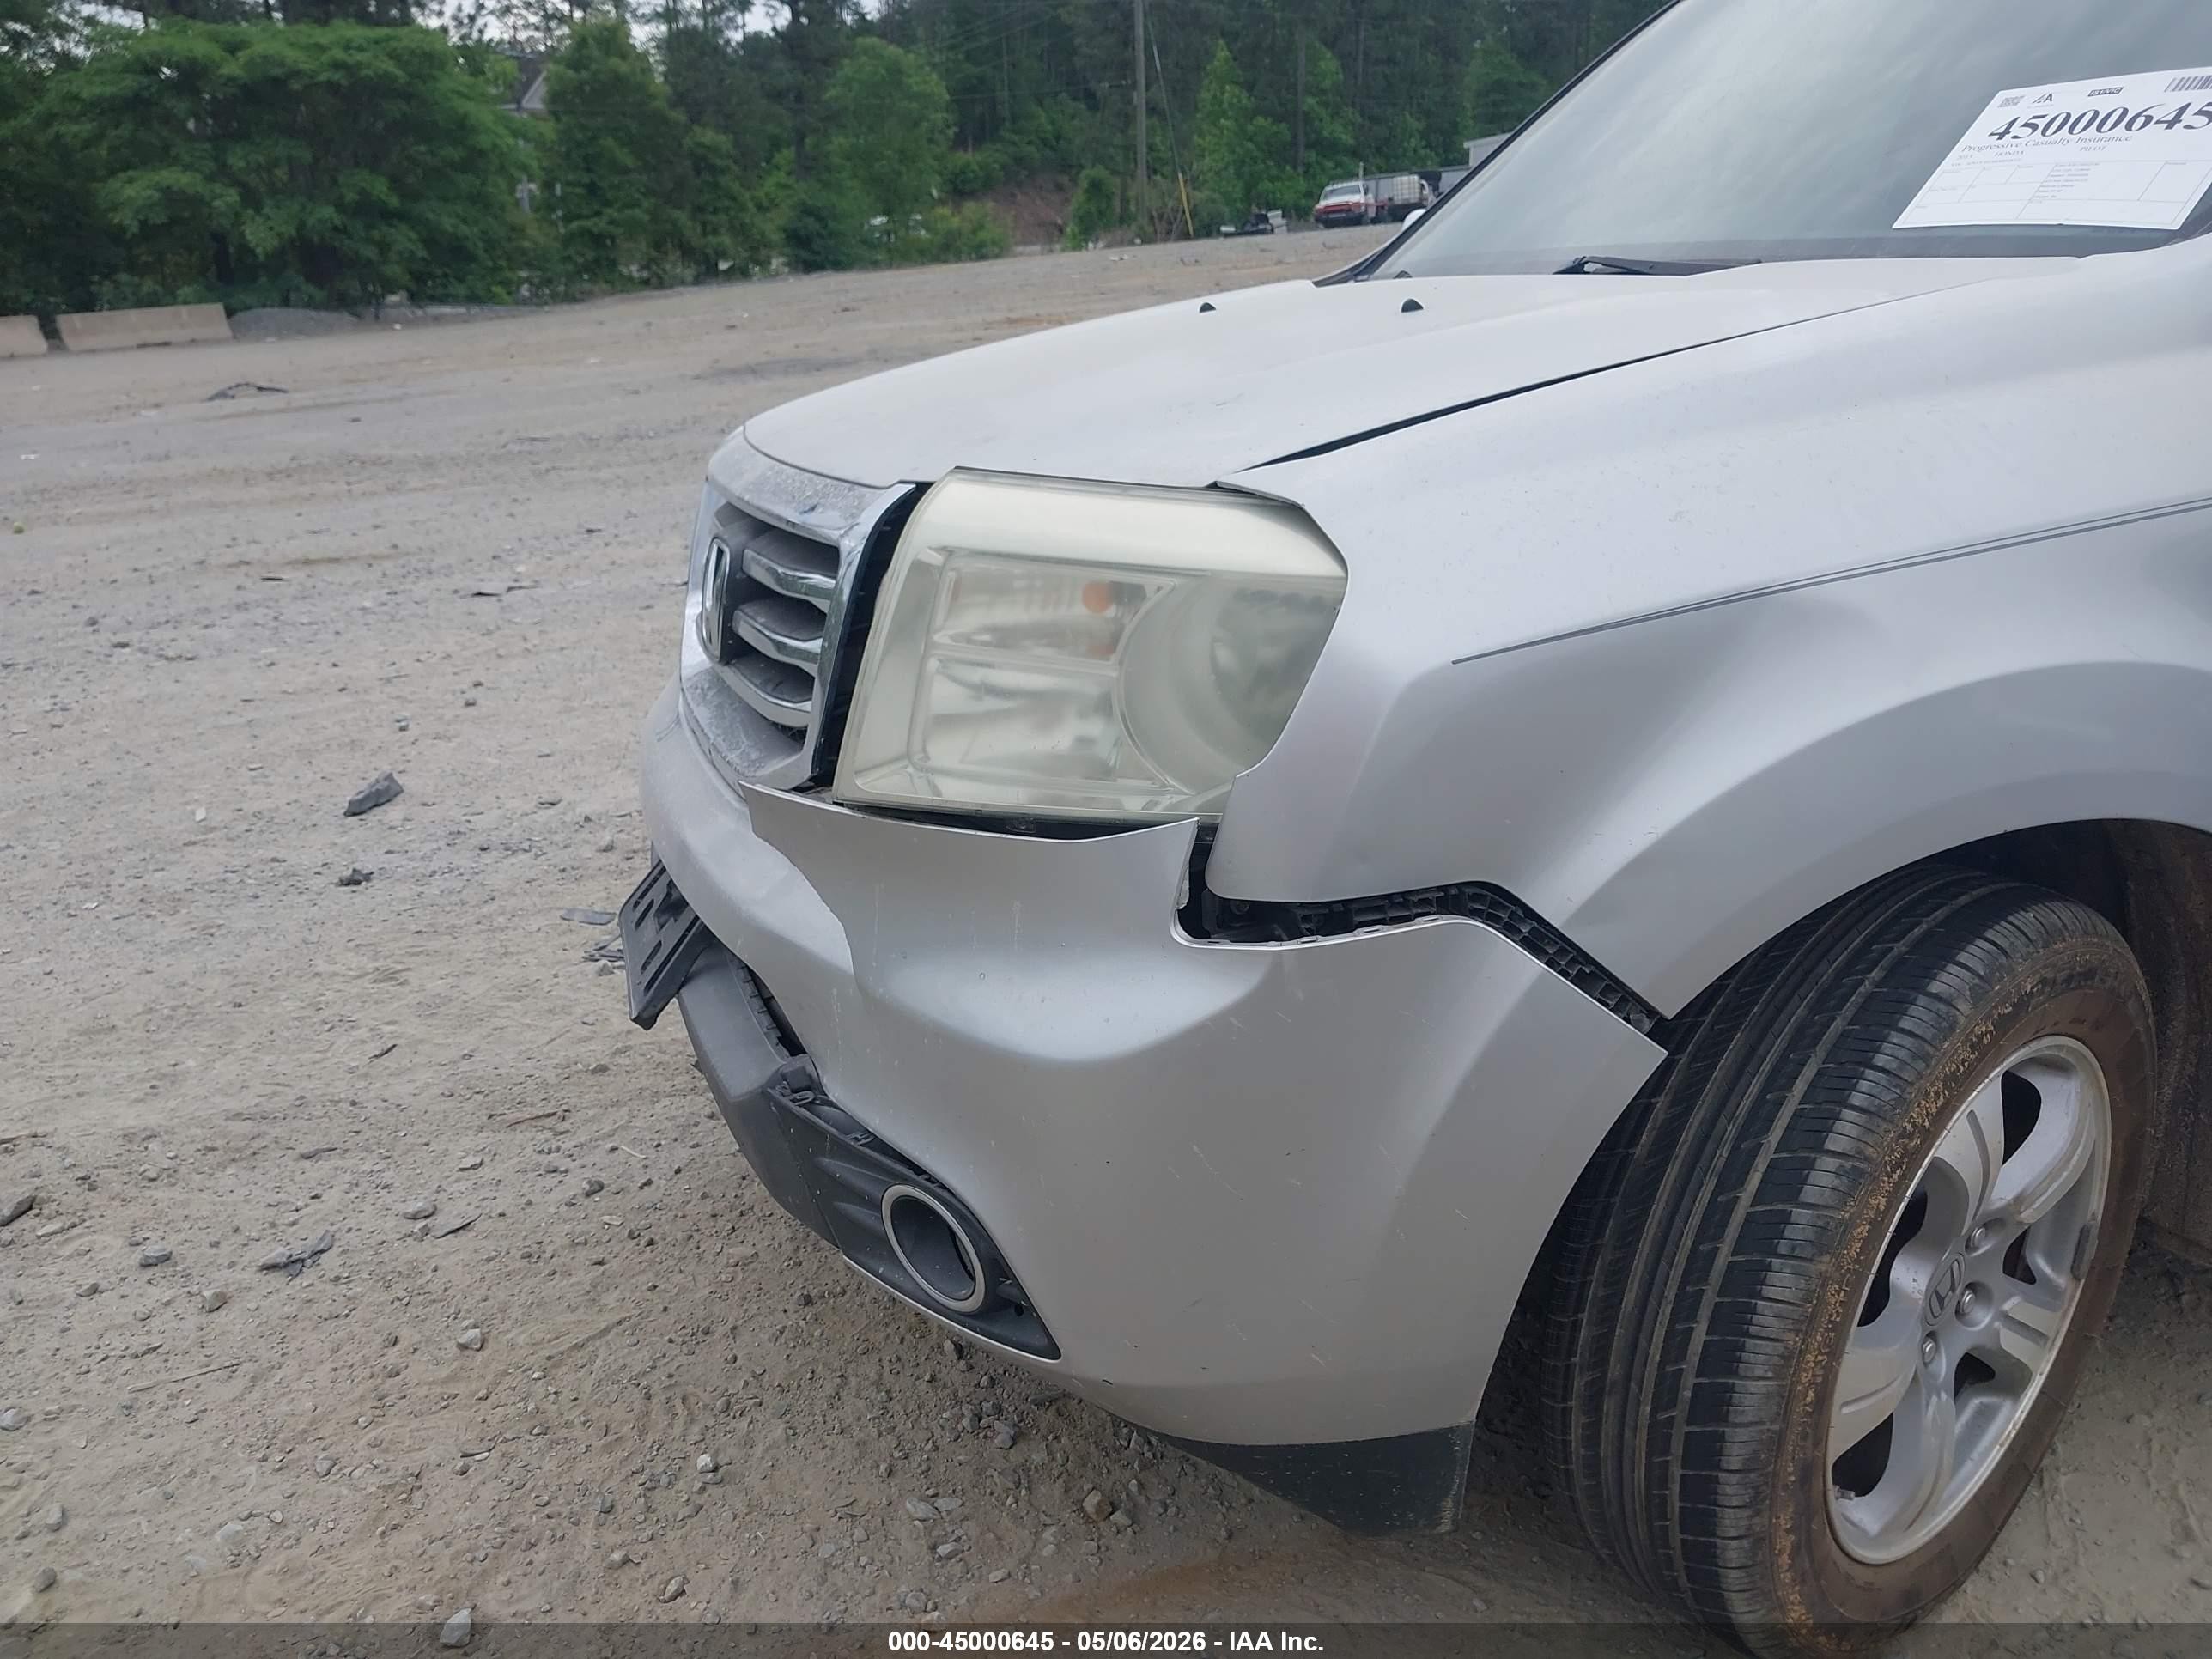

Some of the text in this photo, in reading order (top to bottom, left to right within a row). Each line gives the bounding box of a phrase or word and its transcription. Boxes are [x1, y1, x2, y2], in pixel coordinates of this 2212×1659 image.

[1989, 102, 2212, 140] 45000645
[1961, 135, 2134, 153] Progressive Casualty Insurance
